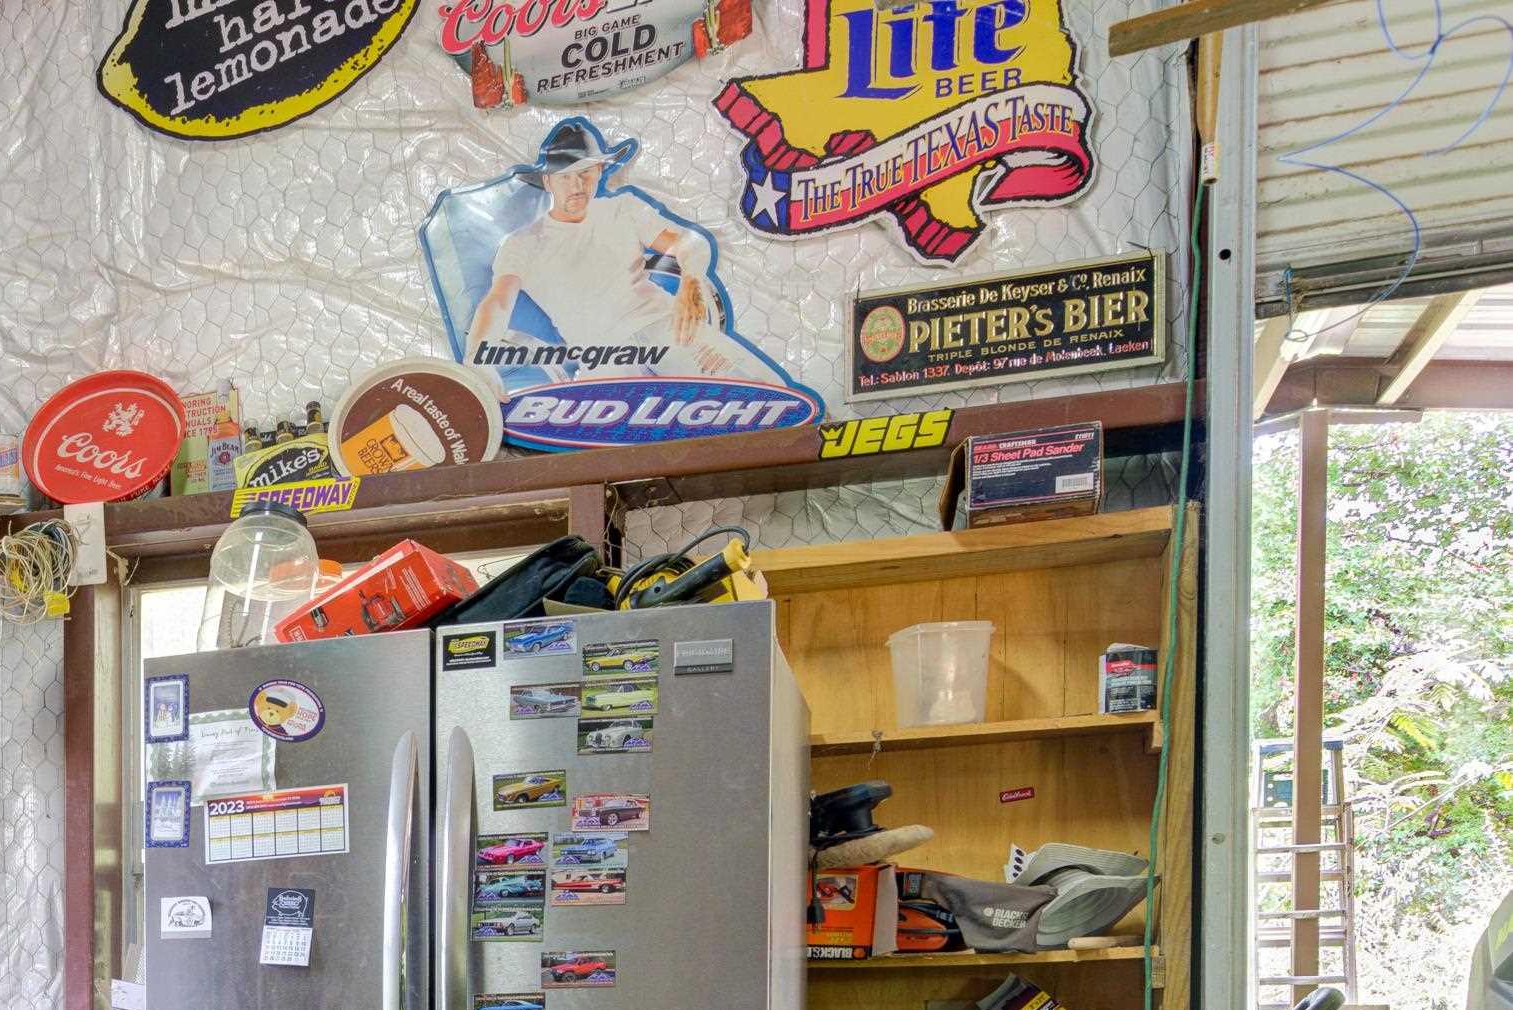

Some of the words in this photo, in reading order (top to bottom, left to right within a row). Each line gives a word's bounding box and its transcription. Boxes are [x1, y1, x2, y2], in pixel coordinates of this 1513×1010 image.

[213, 0, 336, 53] har
[574, 28, 597, 41] BIG
[602, 14, 640, 33] GAME
[561, 24, 656, 69] COLD
[832, 0, 1027, 100] Lite
[536, 41, 686, 93] REFRESHMENT
[935, 67, 1023, 99] BEER
[798, 177, 842, 222] THE
[846, 150, 904, 217] TRUE
[906, 103, 1000, 184] TEXAS
[1004, 95, 1074, 142] TASTE
[907, 290, 976, 314] Brasserie
[980, 288, 998, 303] De
[1002, 281, 1056, 302] Keyser
[1058, 279, 1068, 293] &
[1093, 266, 1146, 287] Renaix
[908, 304, 1055, 353] PIETER'S
[1063, 290, 1149, 334] BIER
[472, 340, 528, 366] tim
[532, 341, 670, 370] mcgraw
[927, 349, 973, 363] TRIPLE
[981, 341, 1036, 356] BLONDE
[1044, 338, 1062, 348] DE
[1070, 329, 1125, 344] RENAIX
[880, 370, 920, 385] Sablon
[993, 358, 1007, 370] 97
[1008, 356, 1027, 369] rue
[1029, 354, 1044, 366] de
[185, 397, 212, 410] ORING
[186, 405, 226, 418] TRUCTION
[391, 379, 404, 392] A
[402, 385, 430, 406] real
[423, 398, 449, 429] taste
[444, 425, 460, 441] of
[505, 397, 614, 426] BUD
[632, 398, 802, 427] LIGHT
[186, 417, 212, 428] NUALS
[820, 409, 955, 459] JEGS
[57, 432, 147, 479] Coors
[249, 448, 321, 487] mike's
[973, 453, 989, 464] 1/3
[991, 450, 1021, 462] Sheet
[1023, 446, 1043, 458] Pad
[1045, 443, 1085, 456] Sander
[94, 474, 108, 488] Light
[209, 800, 246, 816] 2023
